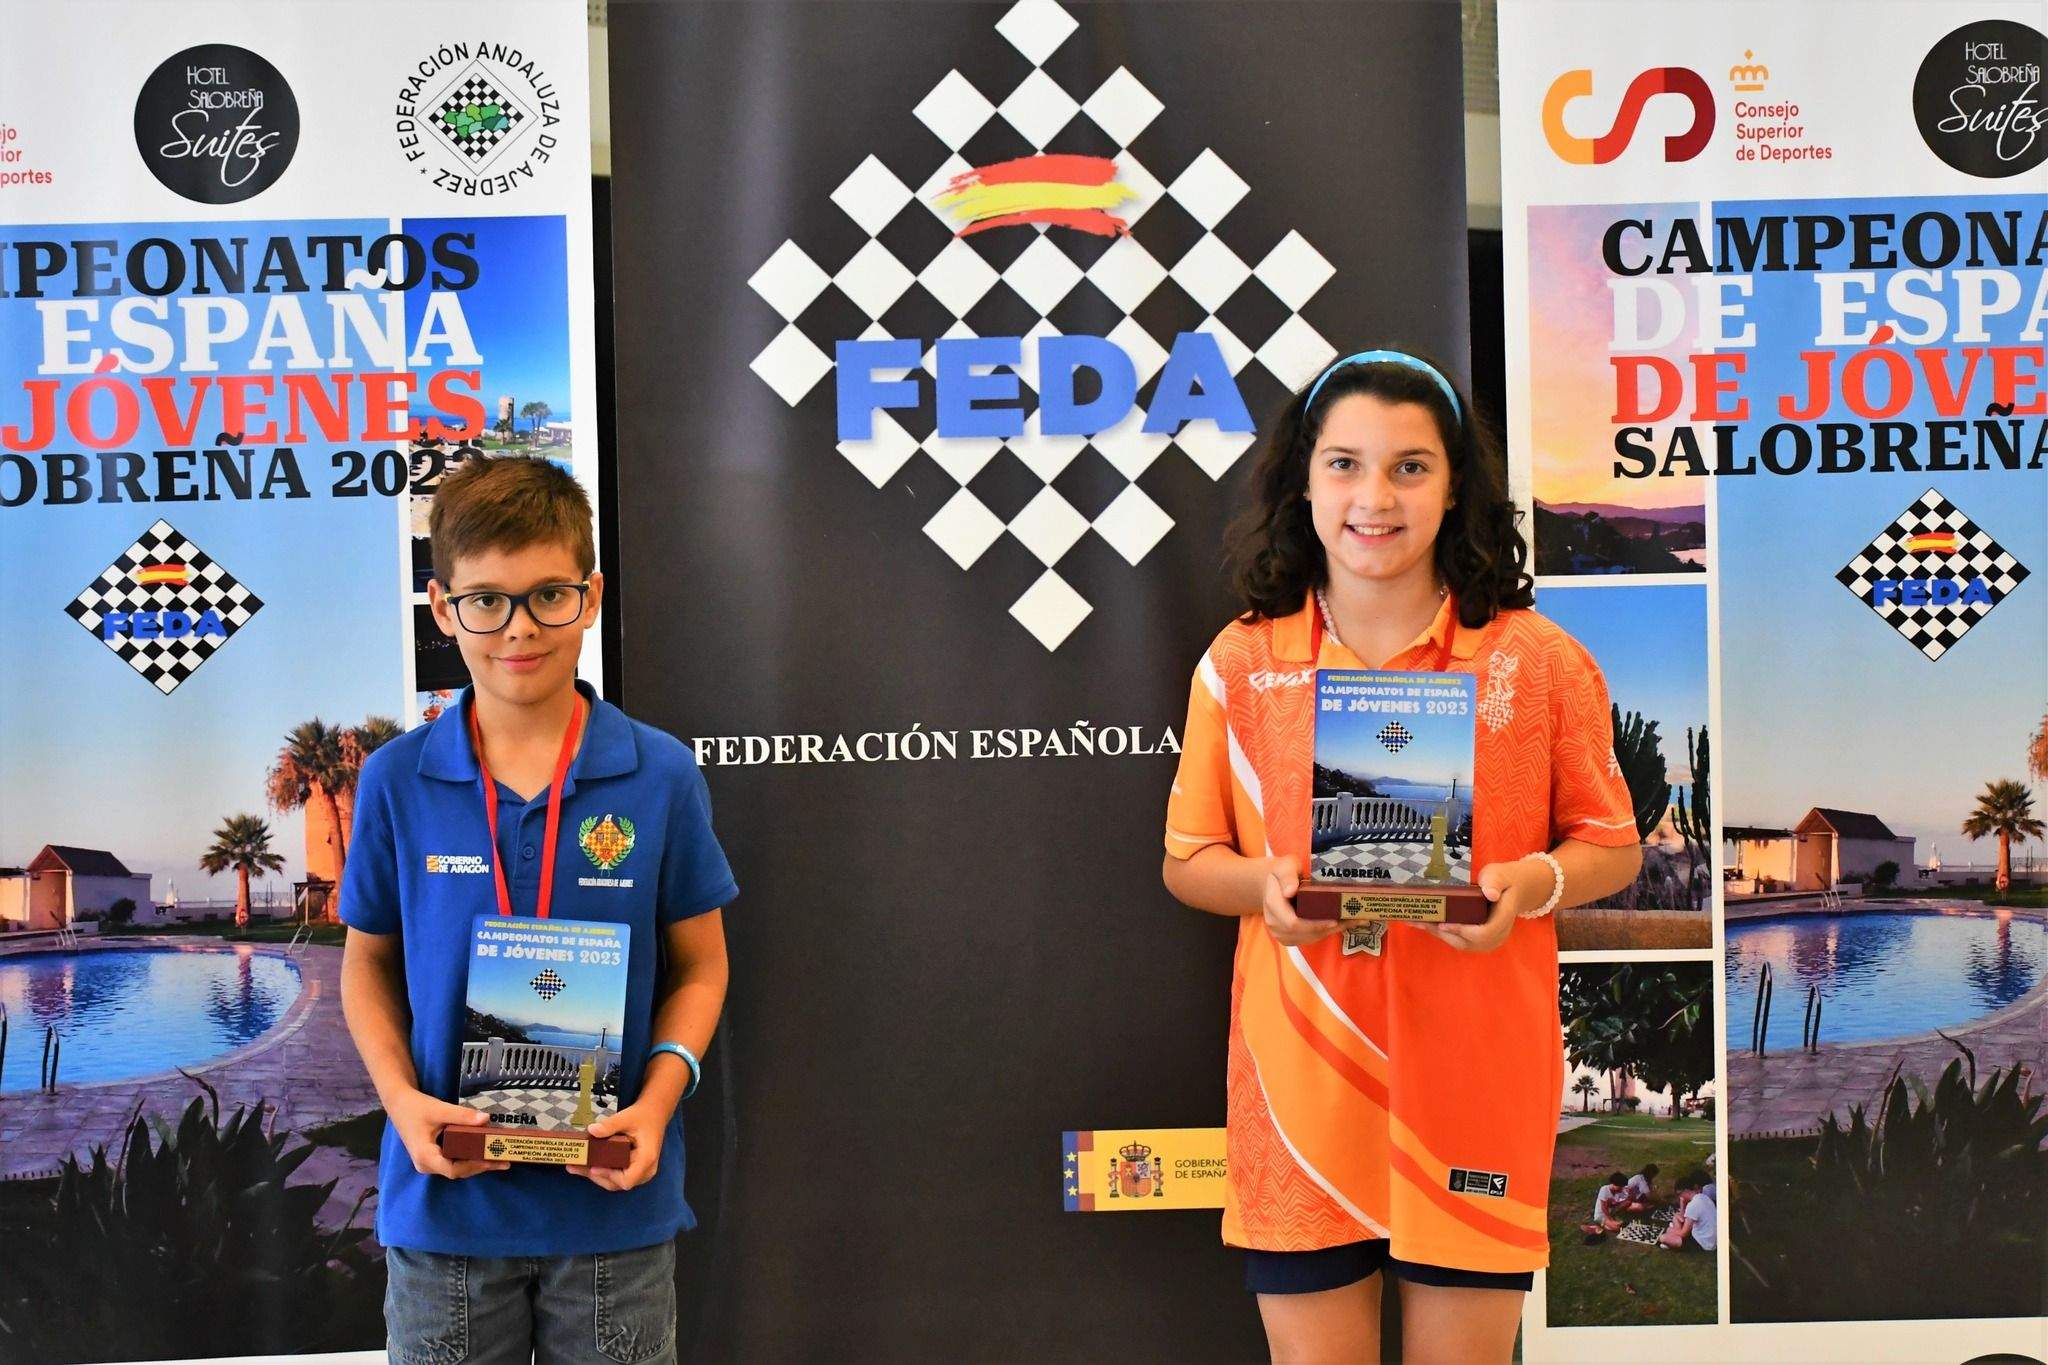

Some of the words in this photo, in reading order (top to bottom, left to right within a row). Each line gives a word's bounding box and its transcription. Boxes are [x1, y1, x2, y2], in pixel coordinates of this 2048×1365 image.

[1965, 42, 2007, 60] HOTEL
[187, 66, 230, 85] HOTEL
[476, 41, 560, 127] ANDALUZA
[1966, 64, 2040, 84] SALOBREÑA
[188, 88, 264, 109] SALOBREÑA
[396, 41, 470, 162] FEDERACIÓN
[1735, 101, 1799, 121] Consejo
[1737, 122, 1804, 142] Superior
[160, 107, 280, 187] Suites
[530, 134, 557, 164] DE
[1736, 144, 1755, 161] de
[1760, 144, 1832, 164] Deportes
[432, 161, 534, 196] AJEDREZ
[0, 231, 480, 298] PEONATOS
[35, 267, 484, 376] ESPAÑA
[1607, 274, 1757, 352] DE
[835, 332, 1257, 441] FEDA
[1610, 353, 1750, 424] DE
[1, 353, 487, 452] JÓVENES
[332, 448, 484, 498] 202
[1873, 577, 1993, 607] FEDA
[103, 609, 228, 640] FEDA
[1321, 685, 1404, 697] CAMPEONATOS
[1406, 688, 1421, 697] DE
[1424, 687, 1468, 698] ESPAÑA
[1321, 698, 1342, 712] DE
[1348, 697, 1420, 714] JÓVENES
[1426, 701, 1468, 715] 2023
[691, 722, 959, 766] FEDERACIÓN
[970, 720, 1182, 759] ESPAÑOLA
[438, 855, 483, 865] GOBIERNO
[439, 864, 449, 873] DE
[1321, 867, 1391, 879] SALOBREÑA
[477, 931, 558, 944] CAMPEONATOS
[562, 936, 576, 946] DE
[579, 936, 622, 949] ESPAÑA
[477, 944, 498, 957] DE
[503, 944, 574, 962] JÓVENES
[580, 950, 621, 965] 2023
[1175, 1170, 1188, 1179] DE
